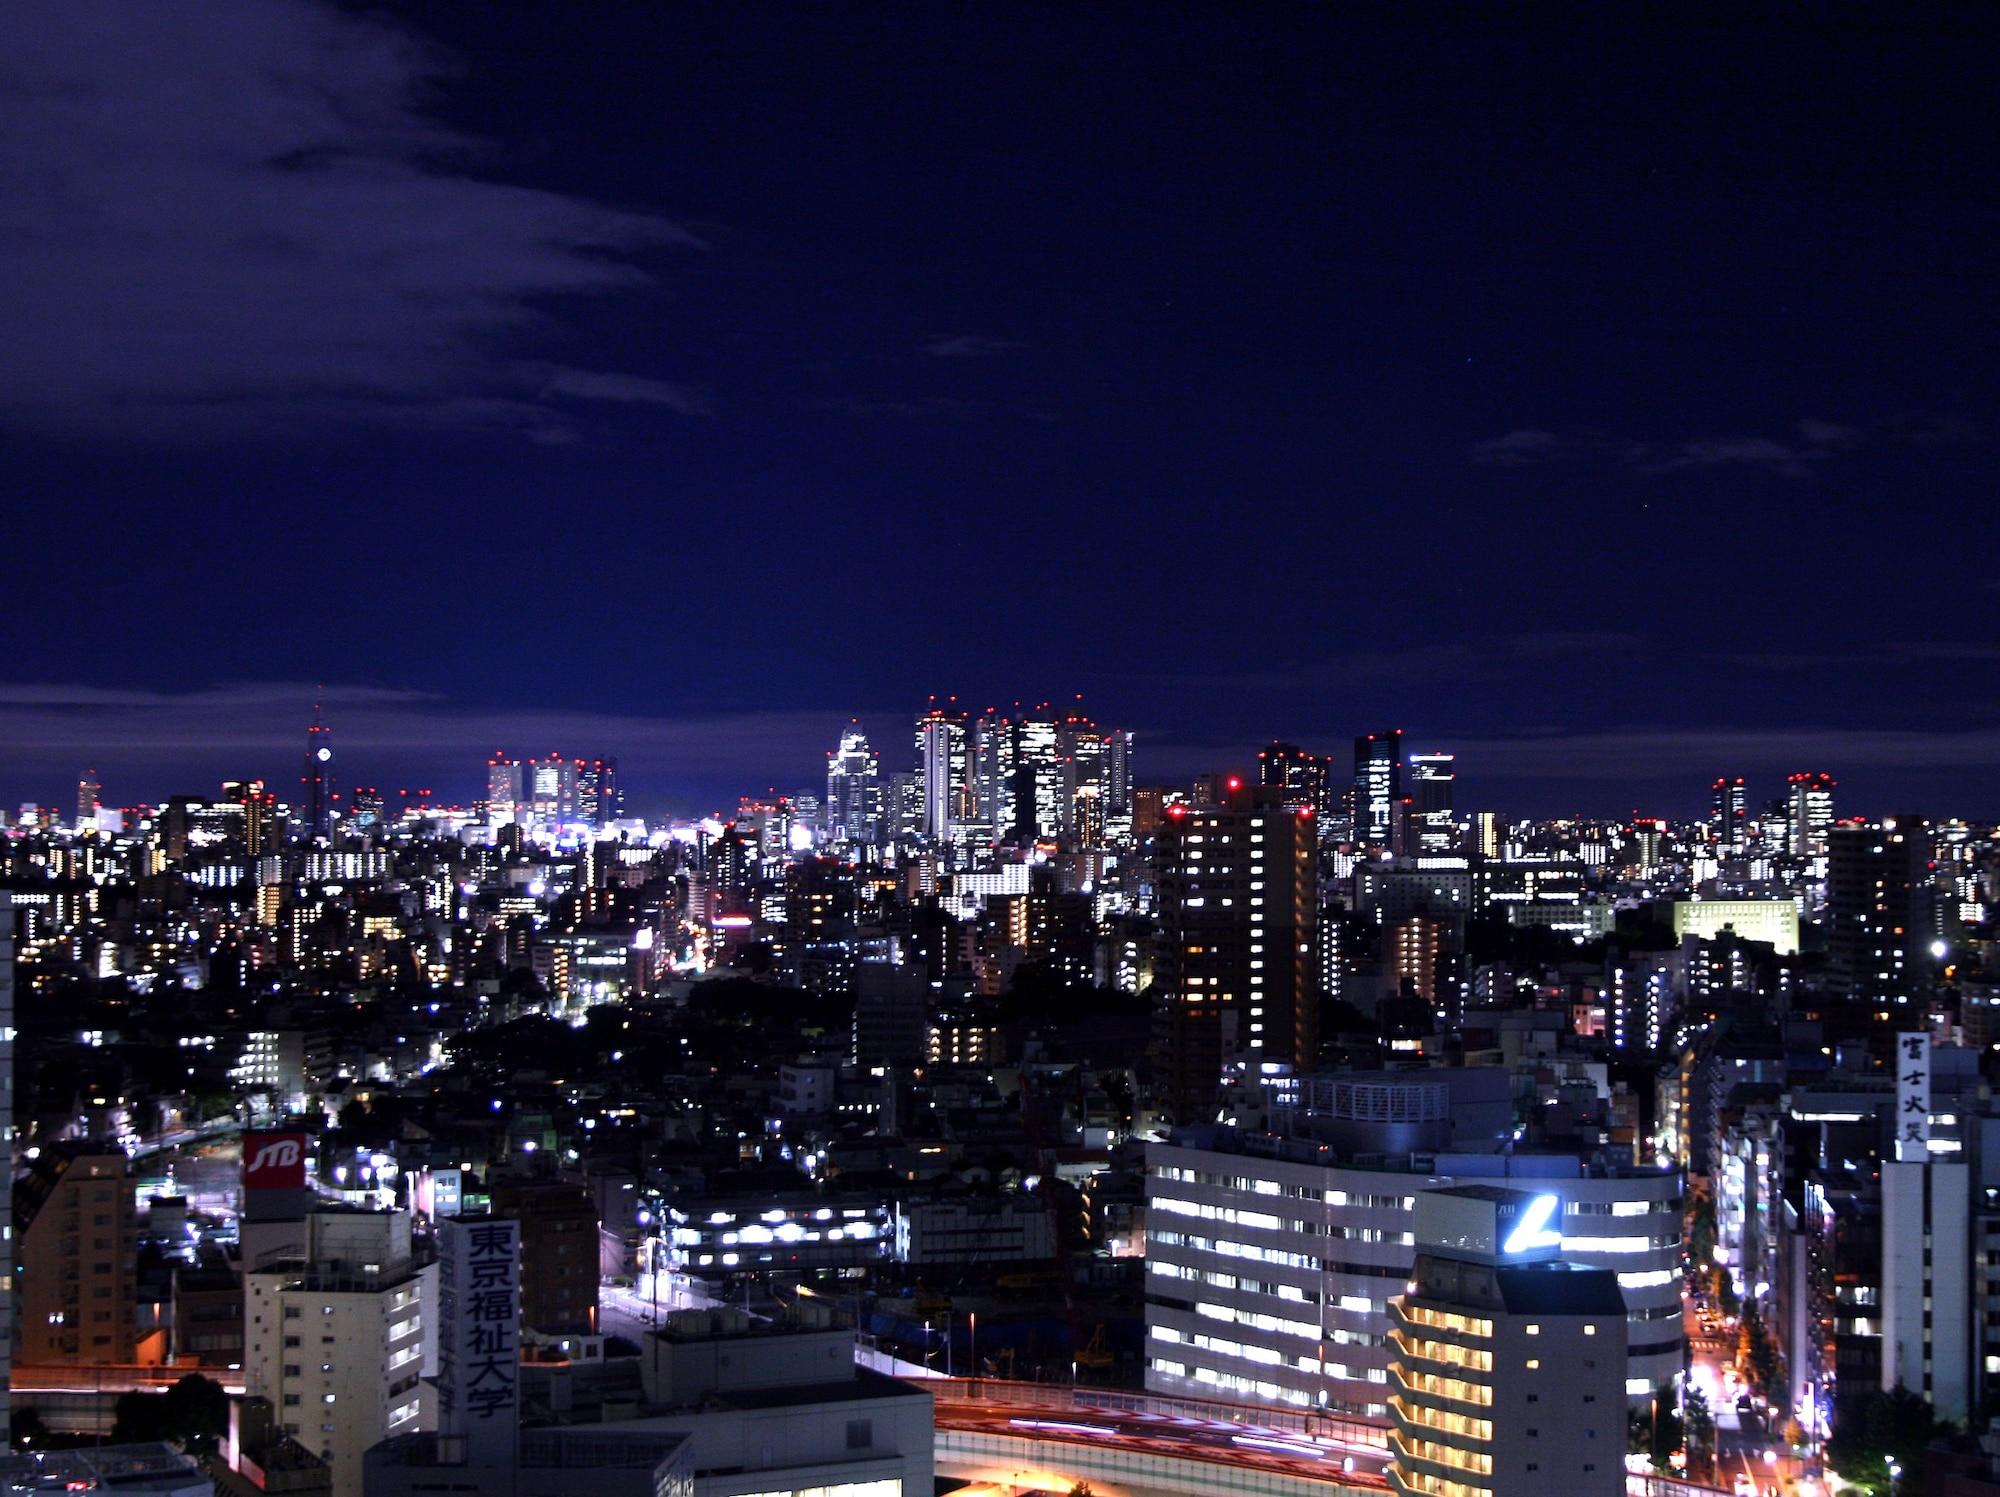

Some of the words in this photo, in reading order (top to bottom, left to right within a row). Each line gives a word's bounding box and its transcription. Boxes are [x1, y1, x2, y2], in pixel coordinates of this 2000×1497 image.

[248, 1139, 301, 1173] JTB
[466, 1225, 514, 1418] 東京福祉大学
